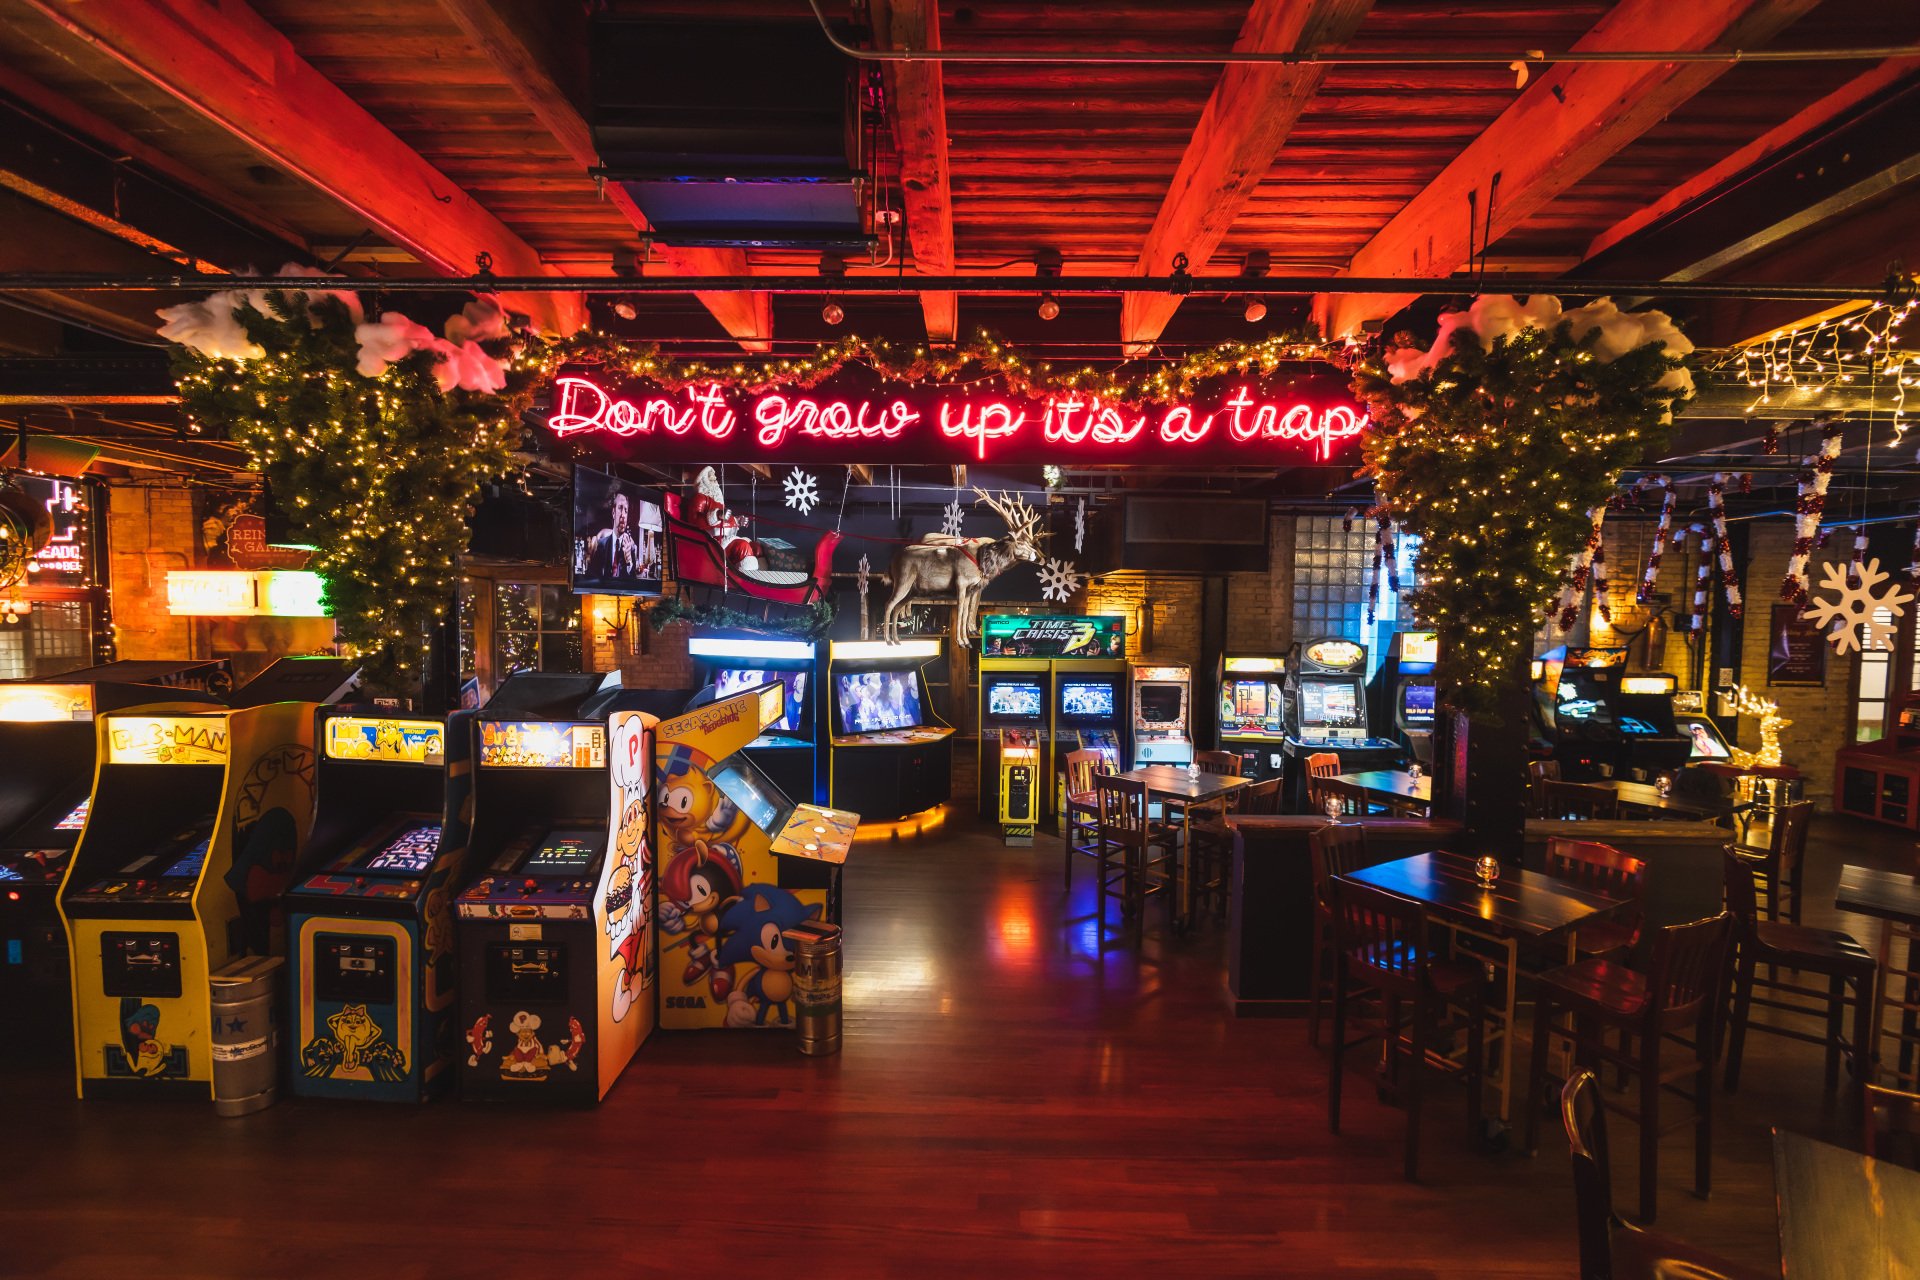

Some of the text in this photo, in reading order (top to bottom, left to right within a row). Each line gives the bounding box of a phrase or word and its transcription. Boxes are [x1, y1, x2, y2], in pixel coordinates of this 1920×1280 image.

[548, 377, 1369, 459] Don't grow up it's a trap
[1012, 629, 1074, 641] CRISIS
[1031, 620, 1073, 629] TIME
[662, 699, 748, 739] SEGASONIC
[703, 713, 740, 736] HEDGEHOG
[112, 725, 226, 754] PC-MAN
[666, 996, 706, 1008] SEGA
